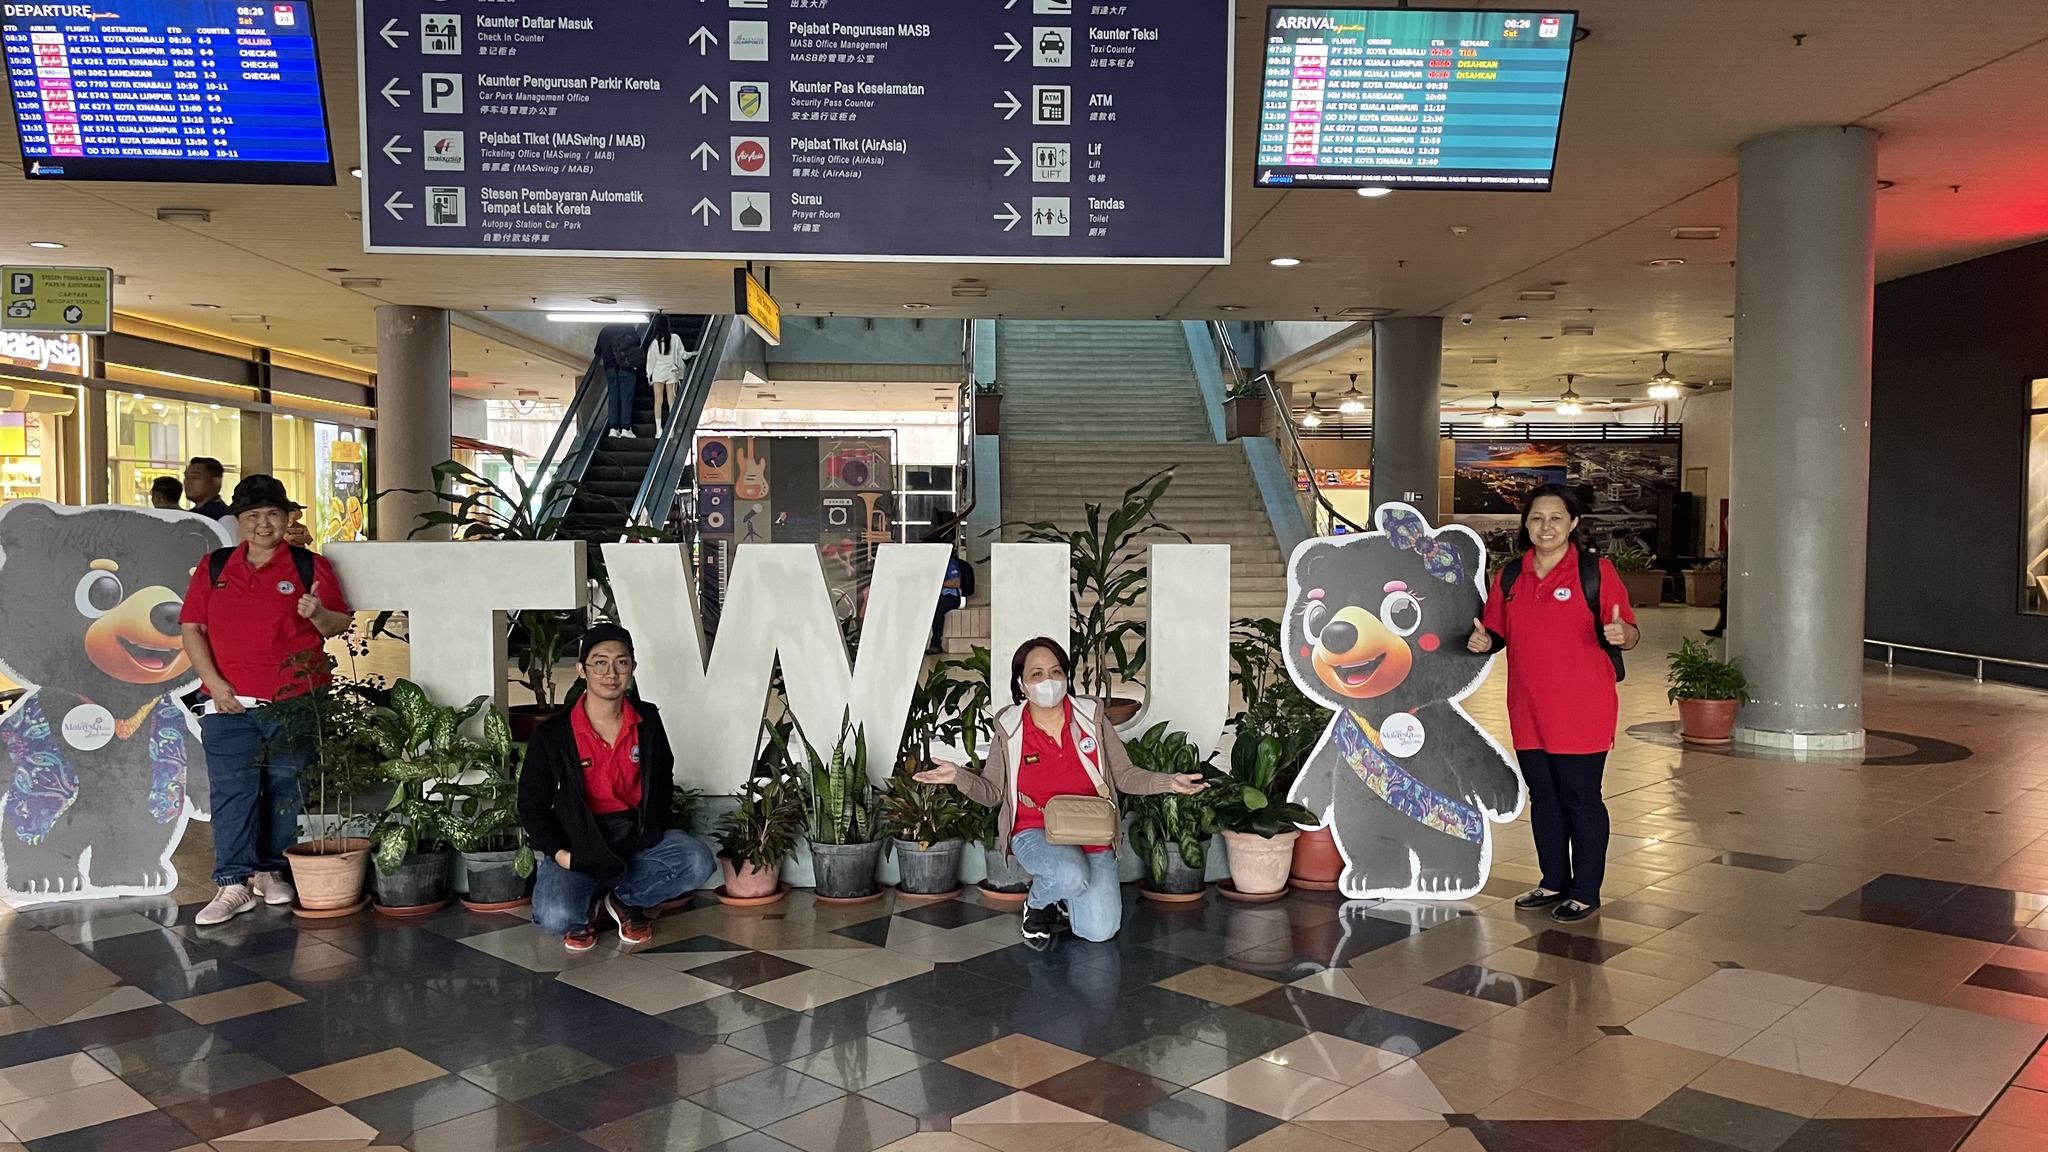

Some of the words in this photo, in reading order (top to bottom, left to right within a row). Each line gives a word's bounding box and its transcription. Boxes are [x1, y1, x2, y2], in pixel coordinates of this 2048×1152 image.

[4, 4, 91, 17] DEPARTURE
[237, 7, 264, 16] 08:26
[477, 15, 520, 28] Kaunter
[522, 16, 555, 29] Daftar
[558, 17, 594, 30] Masuk
[1276, 16, 1335, 30] ARRIVAL
[1505, 20, 1531, 29] 08:26
[789, 22, 830, 37] Pejabat
[832, 23, 895, 38] Pengurusan
[898, 24, 931, 37] MASB
[1089, 27, 1130, 40] Kaunter
[1131, 28, 1158, 40] Teksi
[238, 38, 272, 46] CALLING
[477, 32, 502, 41] Check
[504, 33, 512, 41] In
[514, 33, 545, 42] Counter
[1296, 37, 1324, 45] AIRLINE
[1367, 38, 1392, 46] ORIGIN
[790, 39, 813, 48] MASB
[815, 40, 838, 48] Office
[840, 41, 888, 51] Management
[1090, 44, 1105, 53] Taxi
[1106, 44, 1136, 53] Counter
[1366, 48, 1387, 56] KOTA
[1388, 48, 1427, 56] KINABALU
[1459, 49, 1477, 57] TIBA
[173, 59, 195, 67] 10:20
[241, 61, 278, 69] CHECK-IN
[1457, 60, 1498, 69] DISAHKAN
[109, 70, 152, 78] SANDAKAN
[242, 72, 280, 80] CHECK-IN
[1456, 71, 1496, 79] DISAHKAN
[478, 74, 521, 87] Kaunter
[523, 75, 588, 90] Pengurusan
[590, 76, 622, 89] Parkir
[625, 78, 661, 90] Kereta
[790, 80, 832, 93] Kaunter
[834, 82, 854, 94] Pas
[857, 82, 925, 95] Keselamatan
[431, 78, 454, 108] P
[479, 91, 494, 100] Car
[495, 92, 513, 100] Park
[515, 93, 565, 103] Management
[567, 93, 590, 102] Office
[1044, 94, 1060, 102] ATM
[791, 97, 822, 108] Security
[823, 98, 842, 107] Pass
[844, 99, 875, 107] Counter
[1089, 94, 1113, 106] ATM
[479, 131, 521, 146] Pejabat
[523, 132, 549, 145] Tiket
[552, 133, 606, 149] (MASwing
[616, 134, 645, 149] MAB)
[790, 137, 831, 152] Pejabat
[833, 138, 859, 151] Tiket
[861, 138, 907, 154] (AirAsia)
[1088, 143, 1102, 155] Lif
[427, 155, 462, 163] malaysia
[481, 149, 515, 159] Ticketing
[517, 150, 541, 158] Office
[543, 150, 581, 161] (MASwing
[594, 151, 615, 161] MAB)
[792, 154, 825, 165] Ticketing
[827, 155, 849, 164] Office
[852, 156, 884, 167] (AirAsia)
[513, 164, 560, 174] (MASwing
[568, 165, 594, 174] MAB)
[1088, 160, 1101, 169] Lift
[822, 169, 862, 179] (AirAsia)
[1042, 170, 1062, 179] LIFT
[481, 187, 518, 200] Stesen
[521, 188, 588, 203] Pembayaran
[590, 190, 644, 203] Automatik
[791, 192, 823, 205] Surau
[481, 201, 521, 216] Tempat
[523, 202, 554, 214] Letak
[556, 203, 591, 215] Kereta
[1088, 197, 1125, 210] Tandas
[792, 209, 817, 220] Prayer
[819, 210, 841, 219] Room
[1089, 214, 1109, 223] Toilet
[481, 219, 513, 230] Autopay
[515, 220, 543, 229] Station
[545, 220, 559, 229] Car
[563, 221, 582, 230] Park
[14, 274, 31, 294] P
